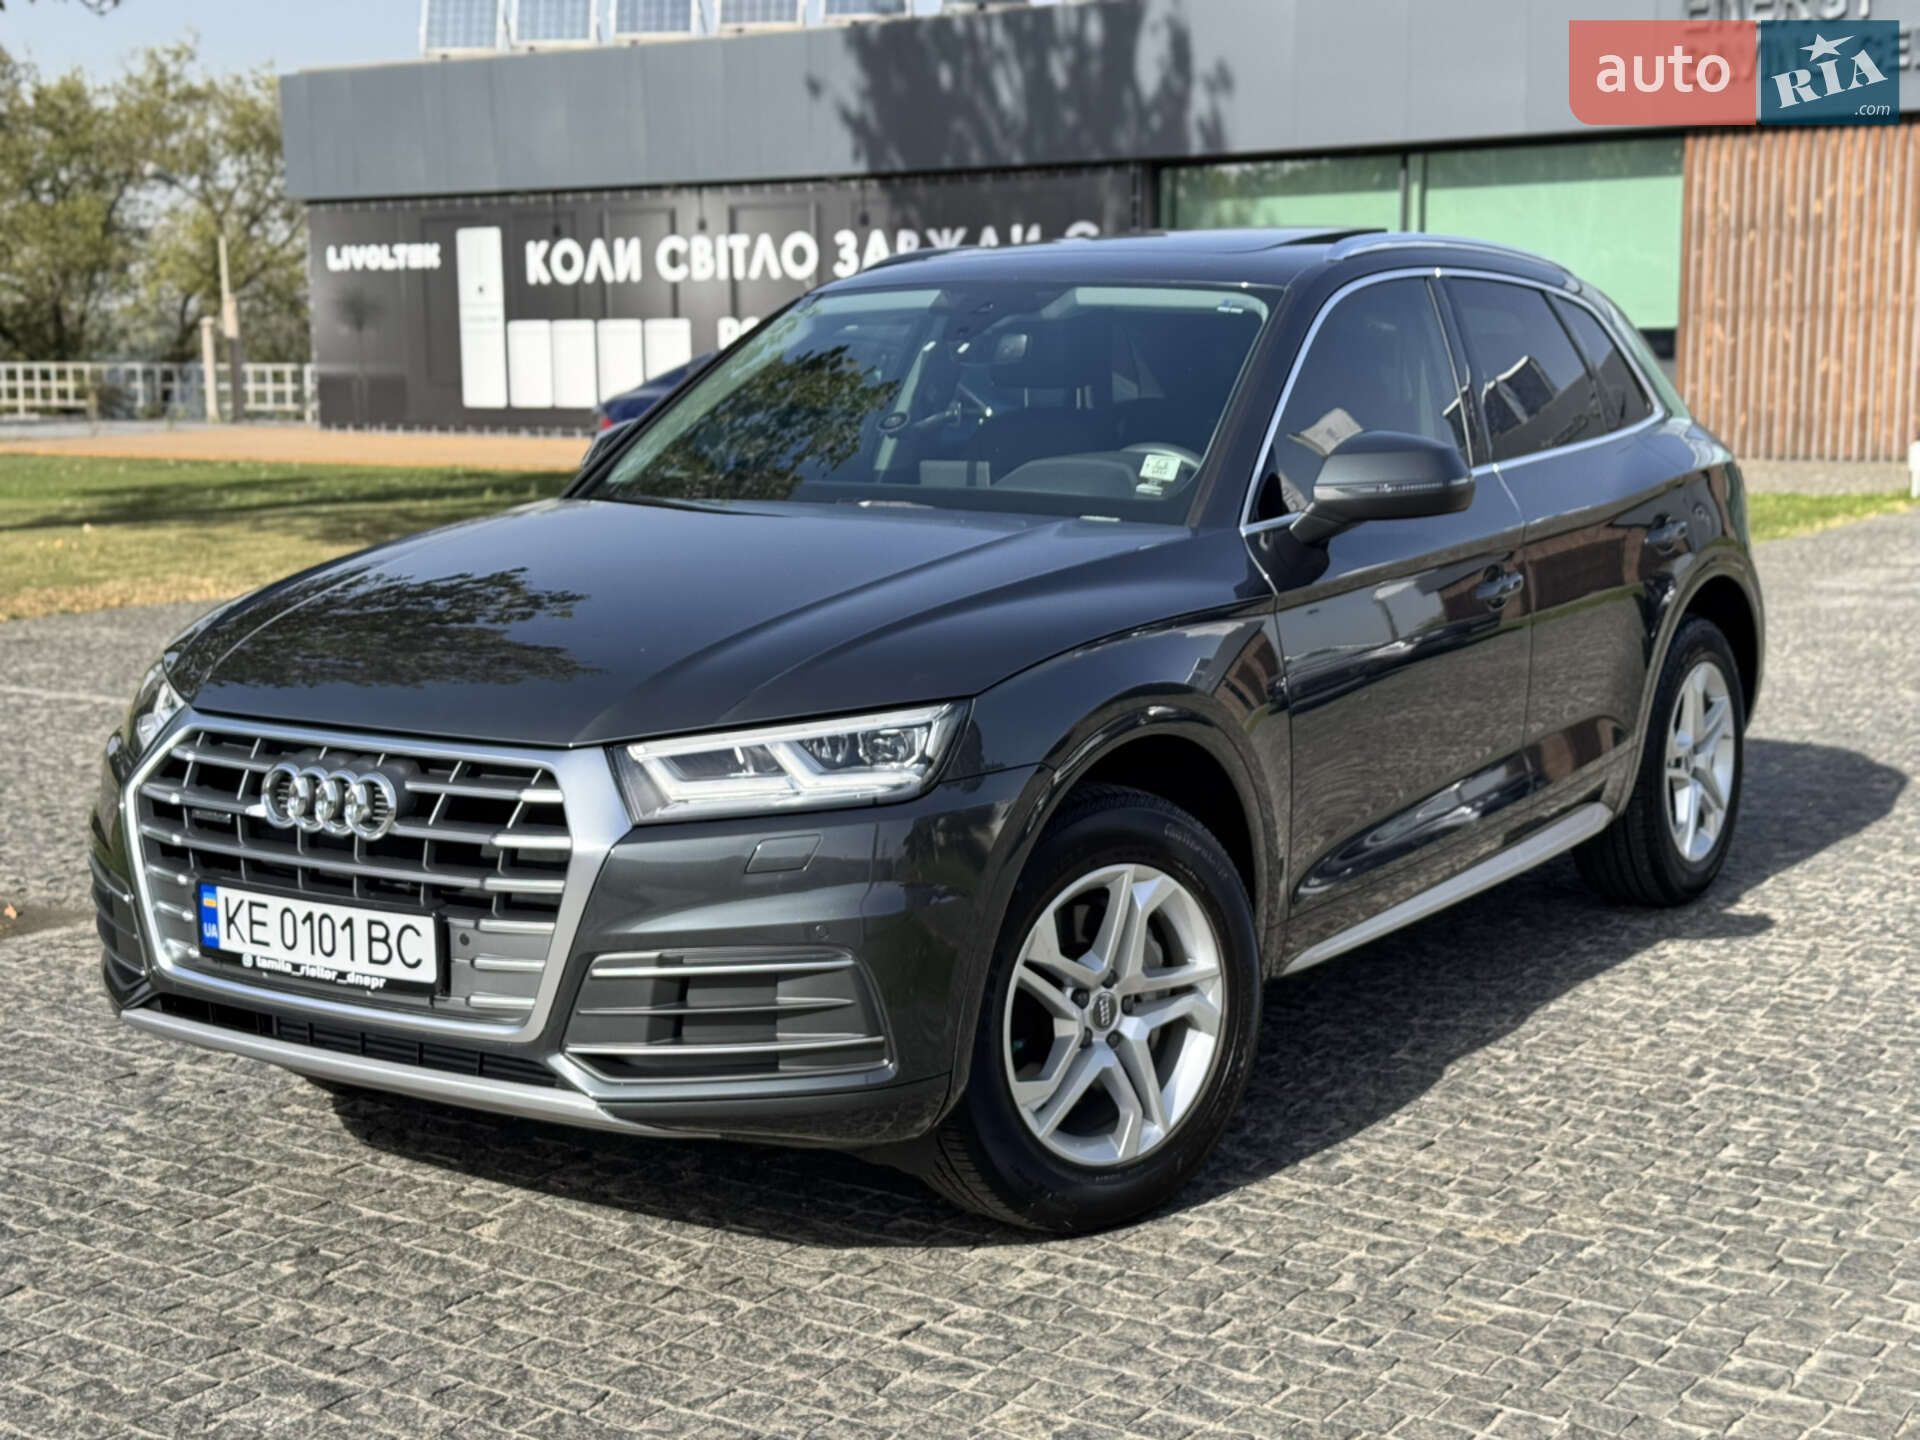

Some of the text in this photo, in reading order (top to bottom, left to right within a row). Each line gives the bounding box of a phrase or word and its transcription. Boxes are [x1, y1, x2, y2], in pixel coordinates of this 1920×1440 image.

[326, 243, 441, 271] LIVOLTEK
[525, 236, 642, 286] КОЛИ
[655, 231, 819, 282] СВІТЛО
[203, 923, 219, 939] UA
[225, 896, 423, 969] KE 0101 BC
